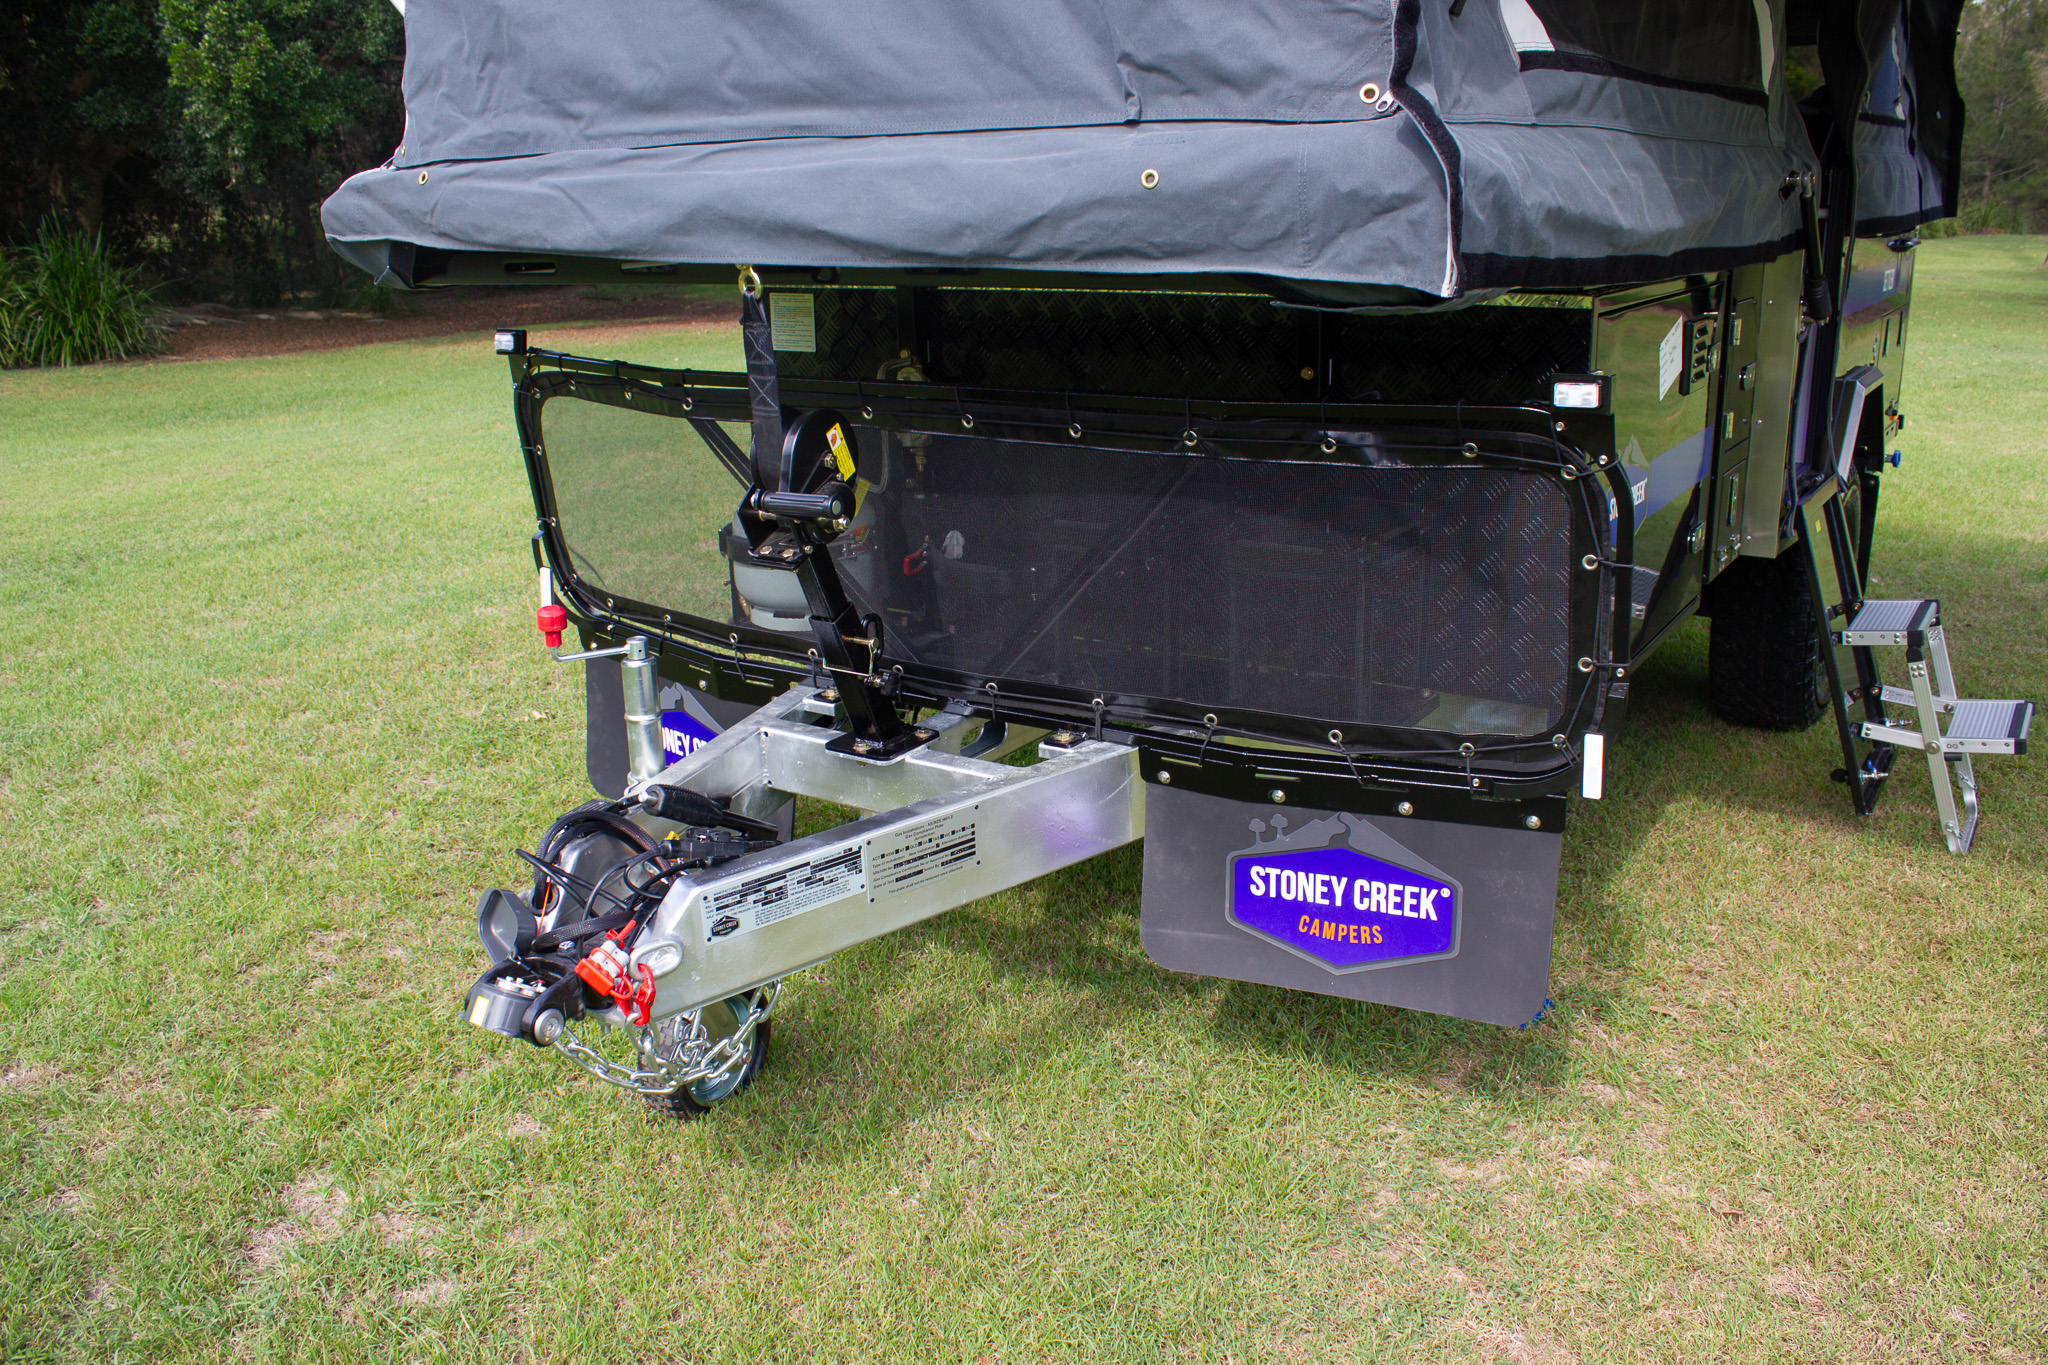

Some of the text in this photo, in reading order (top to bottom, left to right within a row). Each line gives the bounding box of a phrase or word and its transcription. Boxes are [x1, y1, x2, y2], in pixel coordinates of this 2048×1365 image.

[1250, 866, 1438, 920] STONEY CREEK
[1298, 915, 1382, 944] CAMPERS
